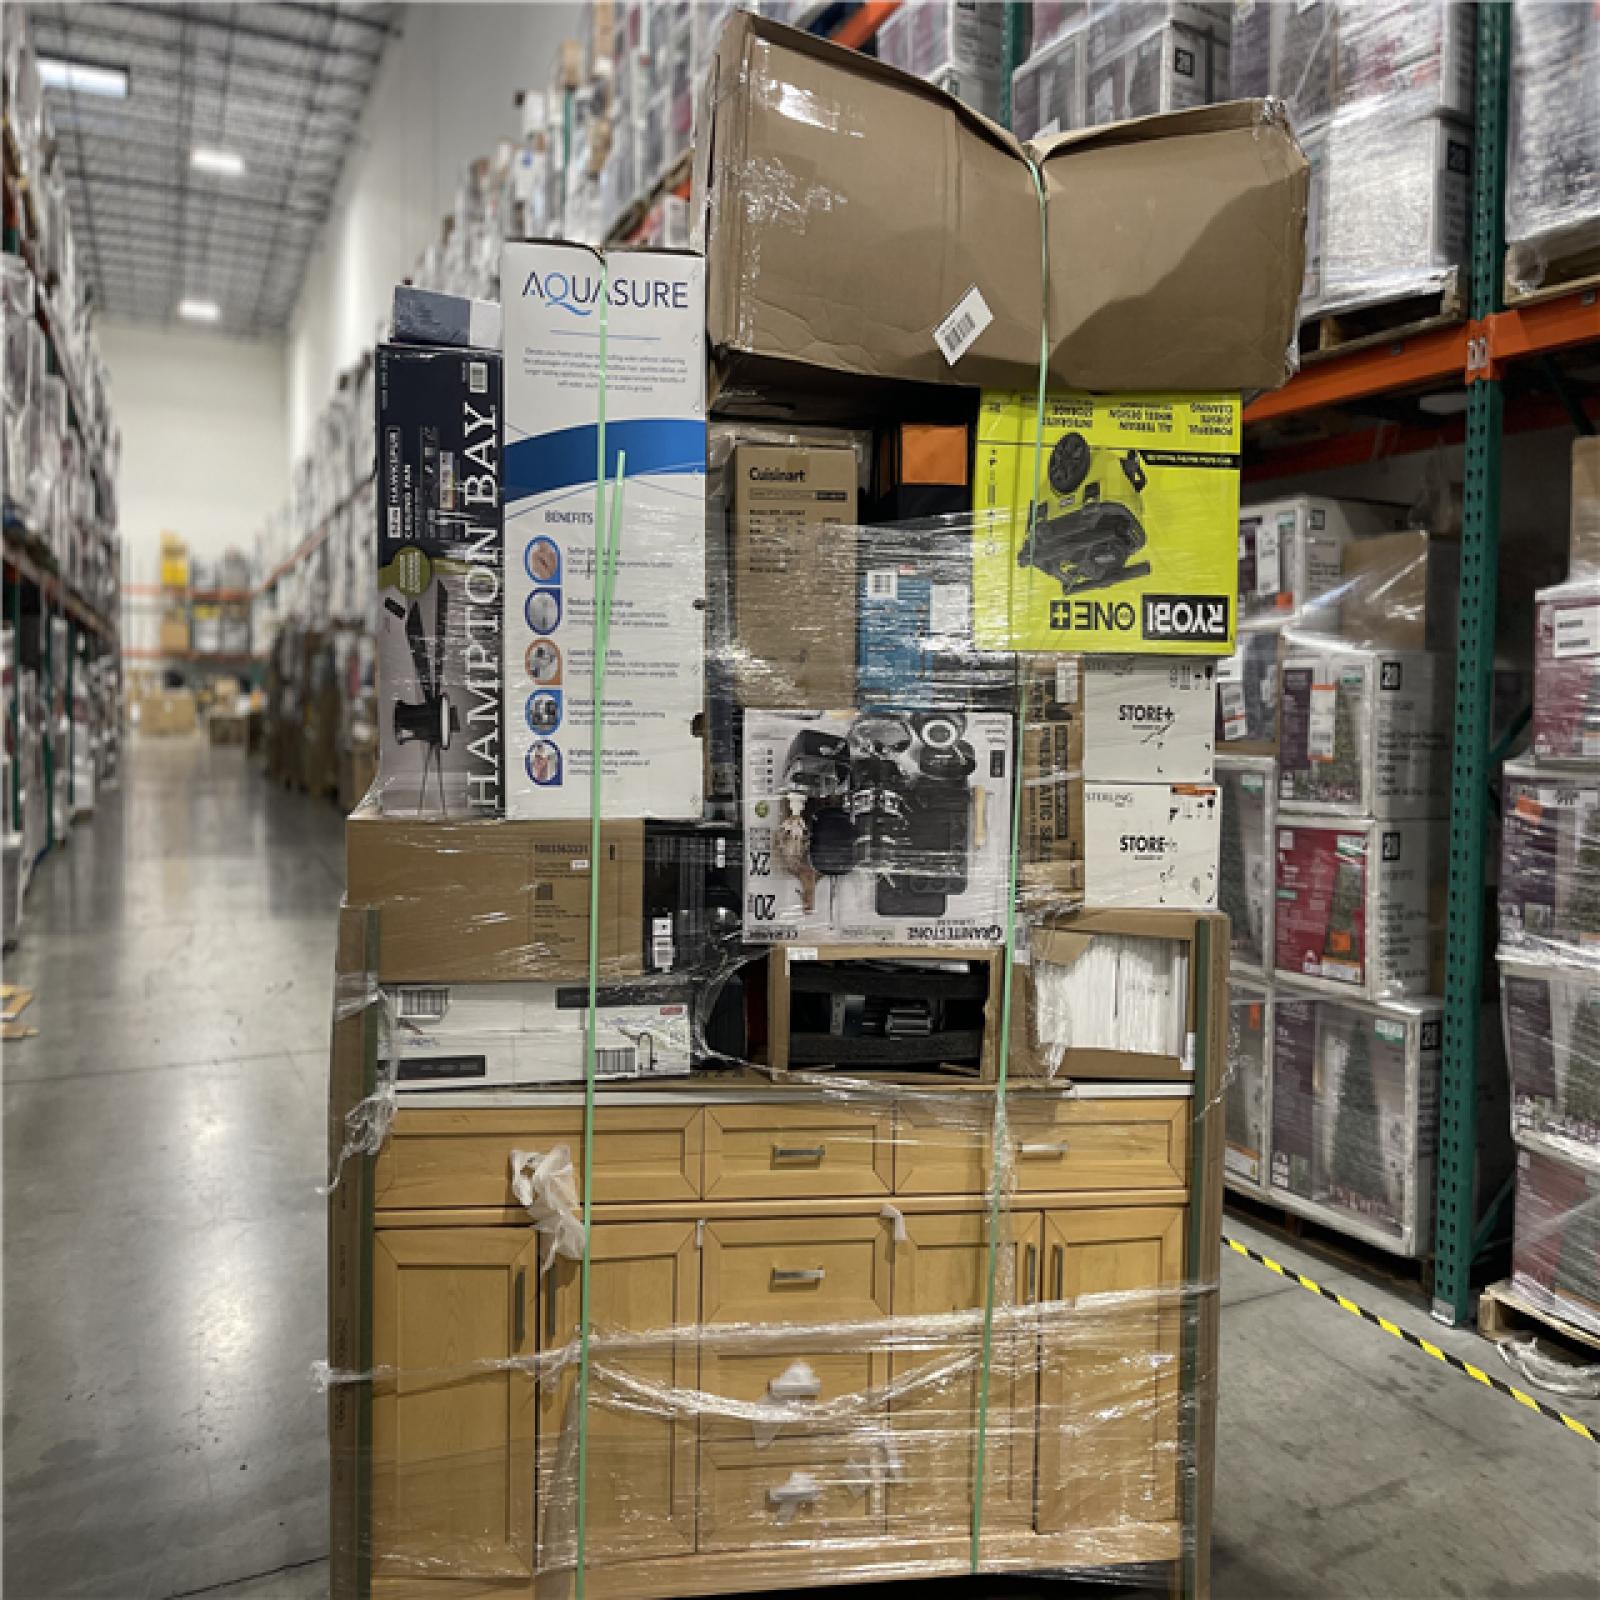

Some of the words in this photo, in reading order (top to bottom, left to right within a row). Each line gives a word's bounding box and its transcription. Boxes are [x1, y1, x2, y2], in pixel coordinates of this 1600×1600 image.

[522, 271, 688, 317] AQUASURE
[464, 401, 497, 508] BAY
[750, 466, 805, 481] Cuisinart
[545, 511, 593, 524] BENEFITS
[1147, 601, 1226, 634] RYOBI
[465, 522, 498, 808] HAMPTON
[1119, 704, 1175, 721] STORE+
[755, 895, 775, 920] 20
